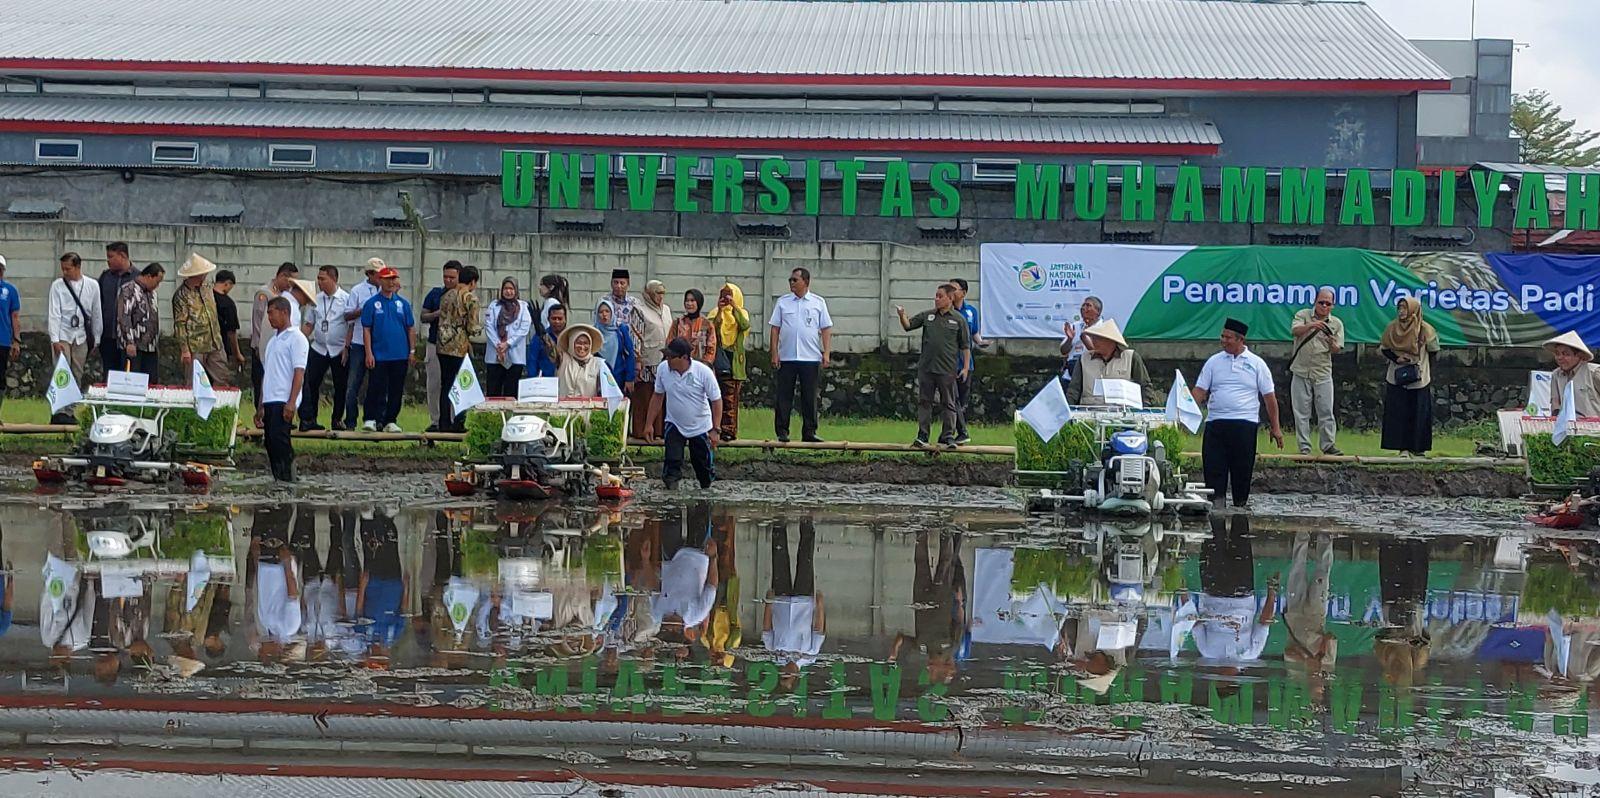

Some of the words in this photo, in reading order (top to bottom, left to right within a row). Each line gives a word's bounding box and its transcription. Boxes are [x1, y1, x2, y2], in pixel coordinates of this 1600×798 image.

[502, 151, 960, 217] UNIVERSITAS
[1015, 163, 1600, 229] MUHAMMADIYAH
[1521, 283, 1594, 312] Padi
